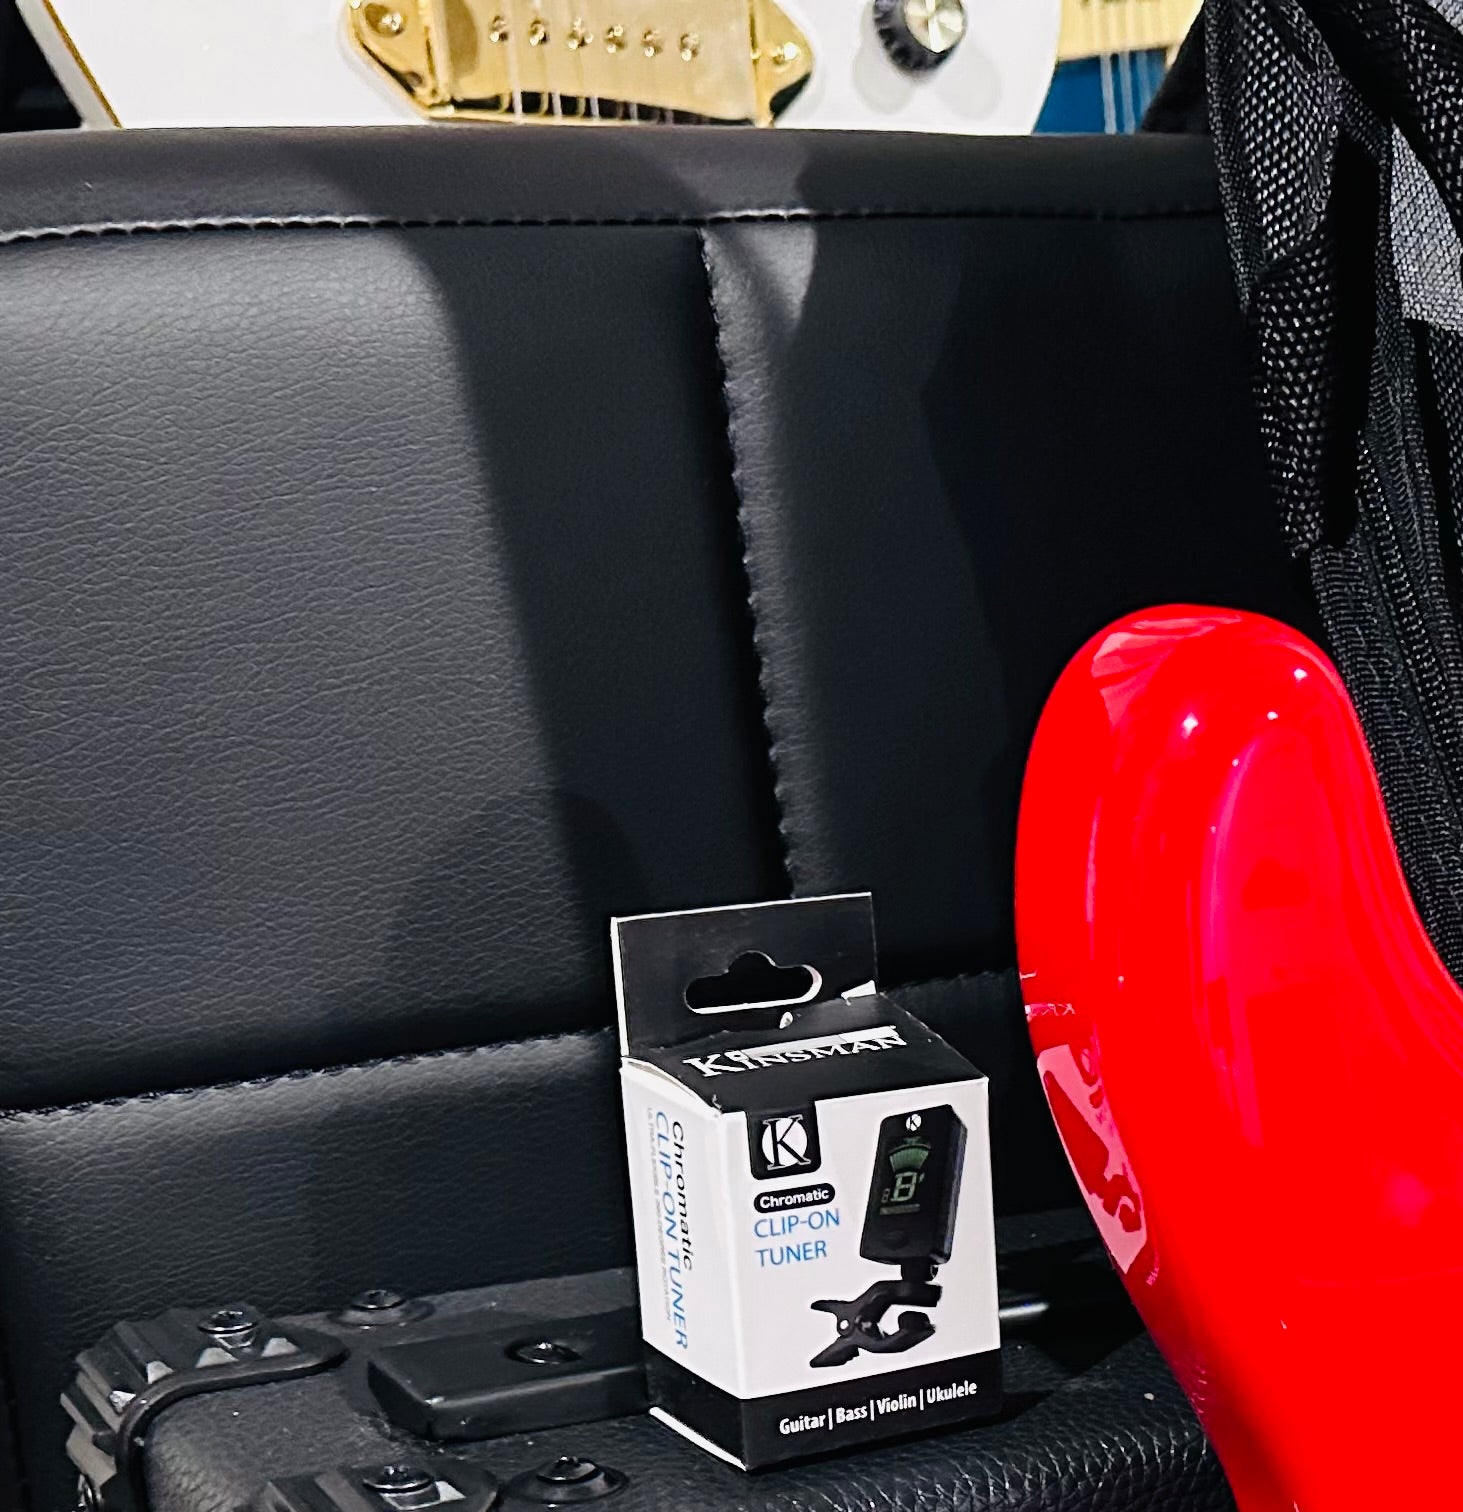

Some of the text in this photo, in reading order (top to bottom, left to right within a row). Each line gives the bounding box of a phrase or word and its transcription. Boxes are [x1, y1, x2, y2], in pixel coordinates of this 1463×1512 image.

[682, 1031, 908, 1077] KINSMAN
[762, 1113, 812, 1171] K
[672, 1121, 694, 1271] Chromatic
[759, 1186, 830, 1209] Chromatic
[754, 1208, 841, 1238] CLIP-ON
[755, 1240, 828, 1267] TUNER
[668, 1249, 689, 1350] TUNER
[778, 1380, 978, 1435] Guitar Bass Violin Ukulele
